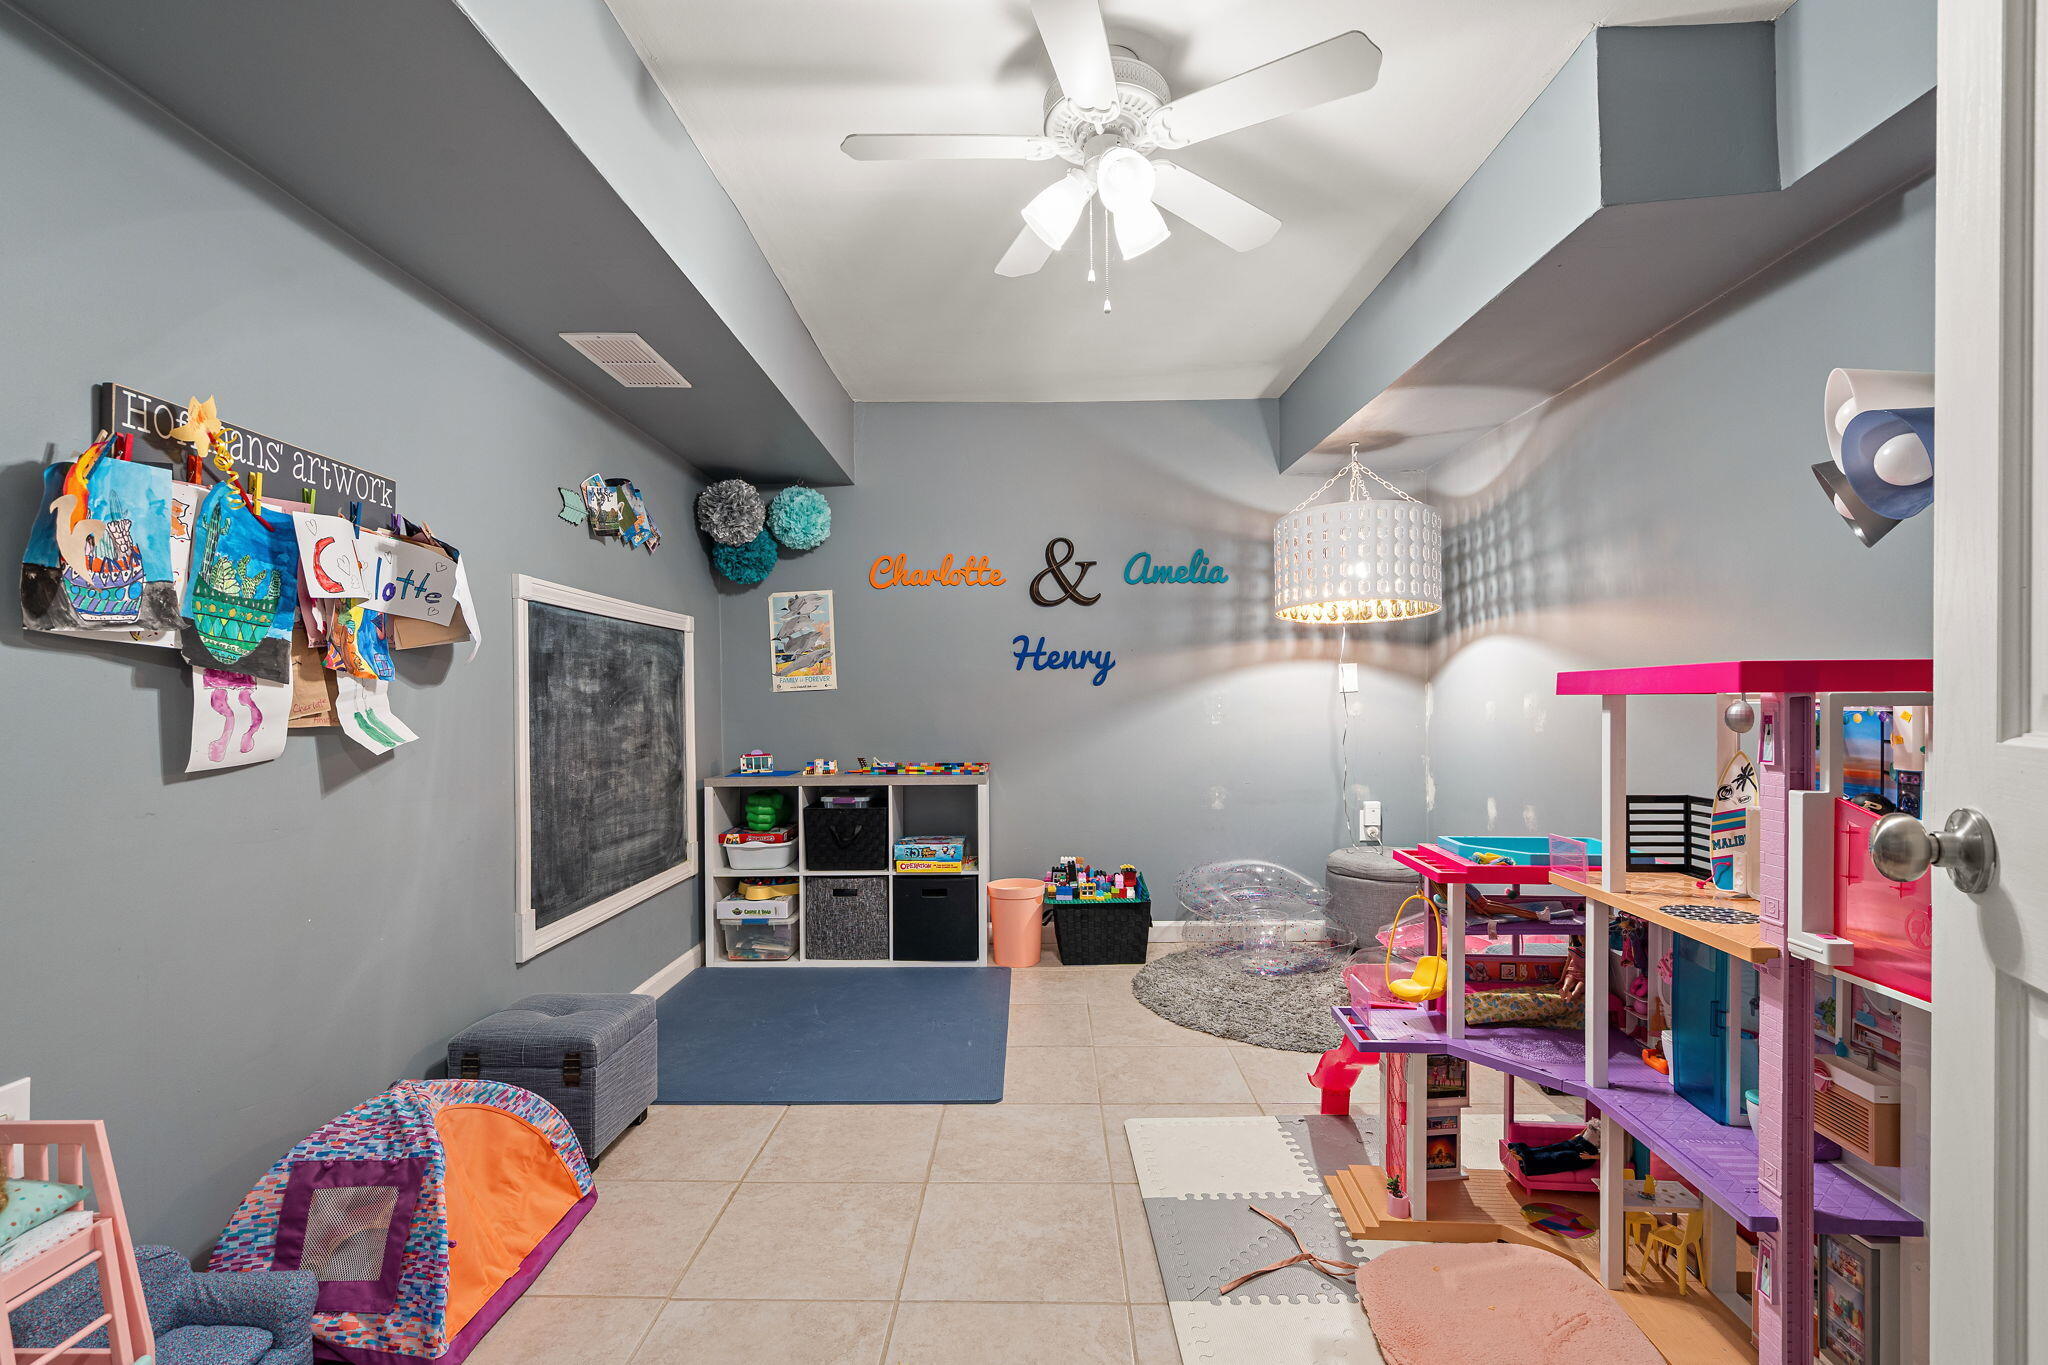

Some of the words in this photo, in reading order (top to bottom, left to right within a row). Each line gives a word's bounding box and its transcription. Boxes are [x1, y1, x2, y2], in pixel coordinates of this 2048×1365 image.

[121, 390, 283, 473] Hofans'
[293, 451, 393, 508] artwork
[869, 553, 1006, 589] Charlotte
[1029, 537, 1101, 607] &
[1124, 549, 1229, 584] Amelia
[1012, 635, 1116, 686] Henry
[900, 862, 932, 871] OPERATION
